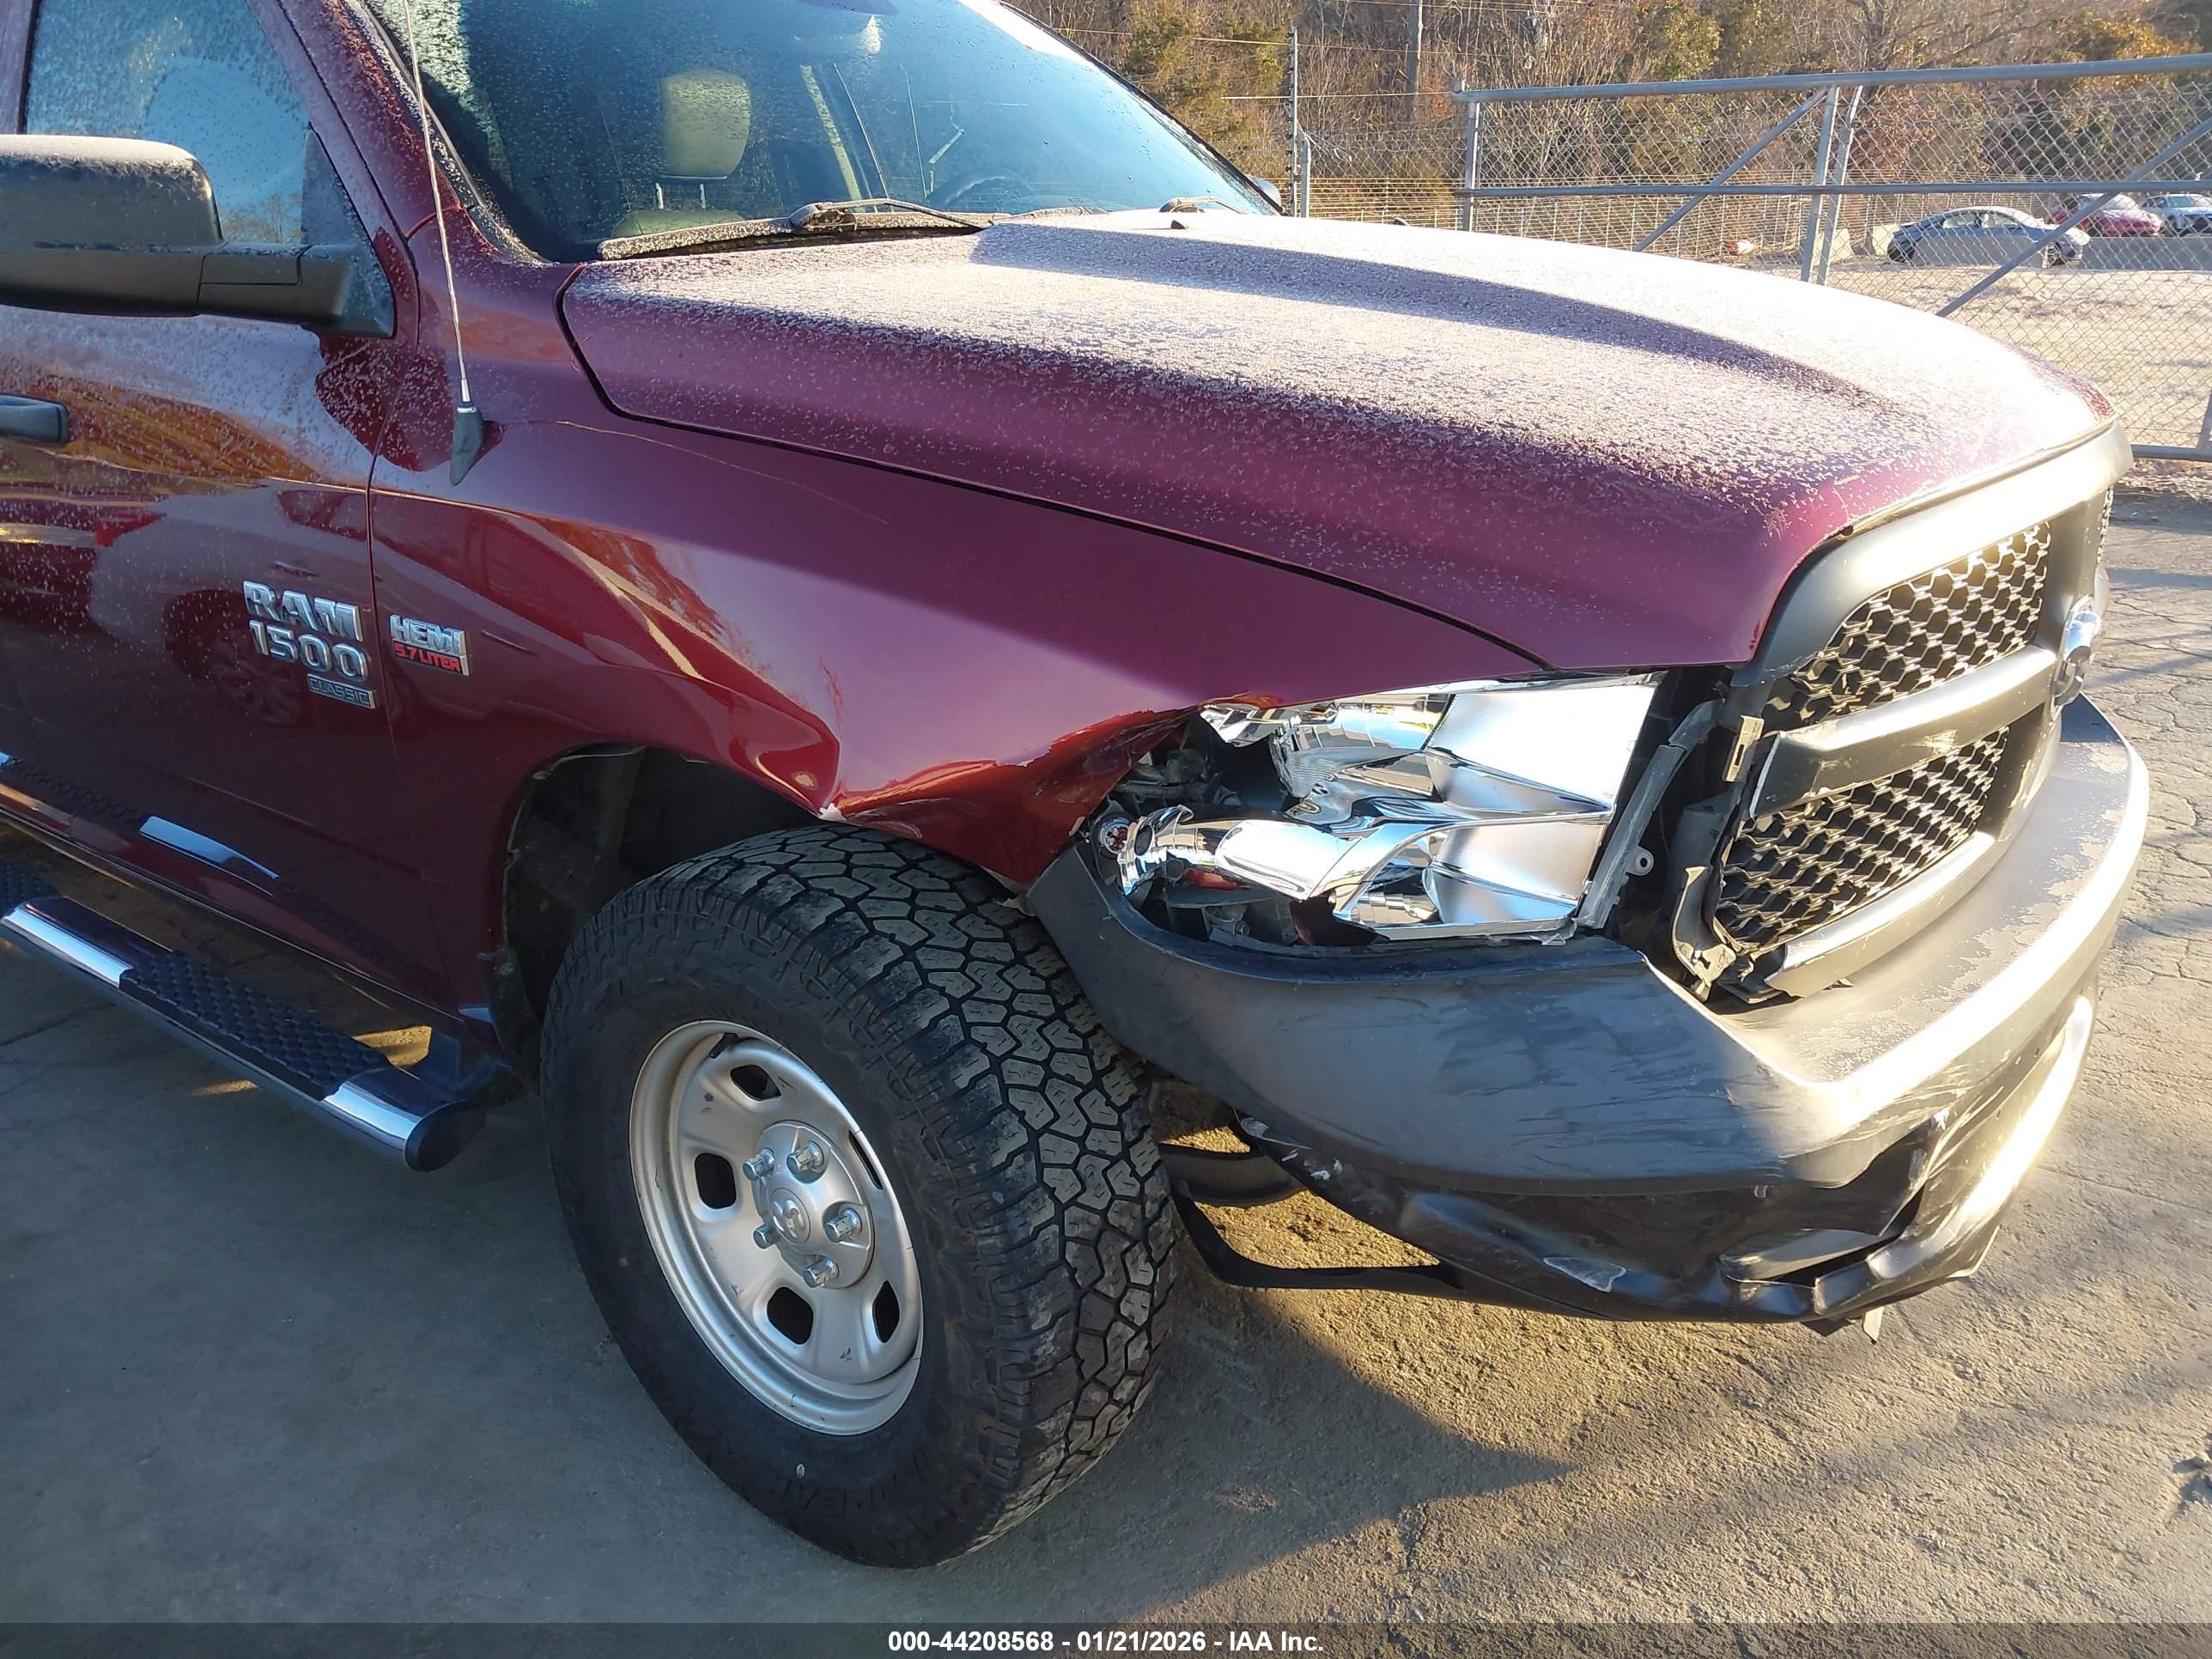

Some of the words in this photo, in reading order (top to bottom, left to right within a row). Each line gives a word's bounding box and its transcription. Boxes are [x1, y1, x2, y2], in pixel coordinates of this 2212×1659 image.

[243, 580, 363, 641] RAM
[249, 619, 369, 683] 1500
[390, 614, 466, 656] HEMI
[394, 642, 417, 660] 5.7
[418, 649, 461, 672] LITER
[309, 677, 372, 707] CLASSIC
